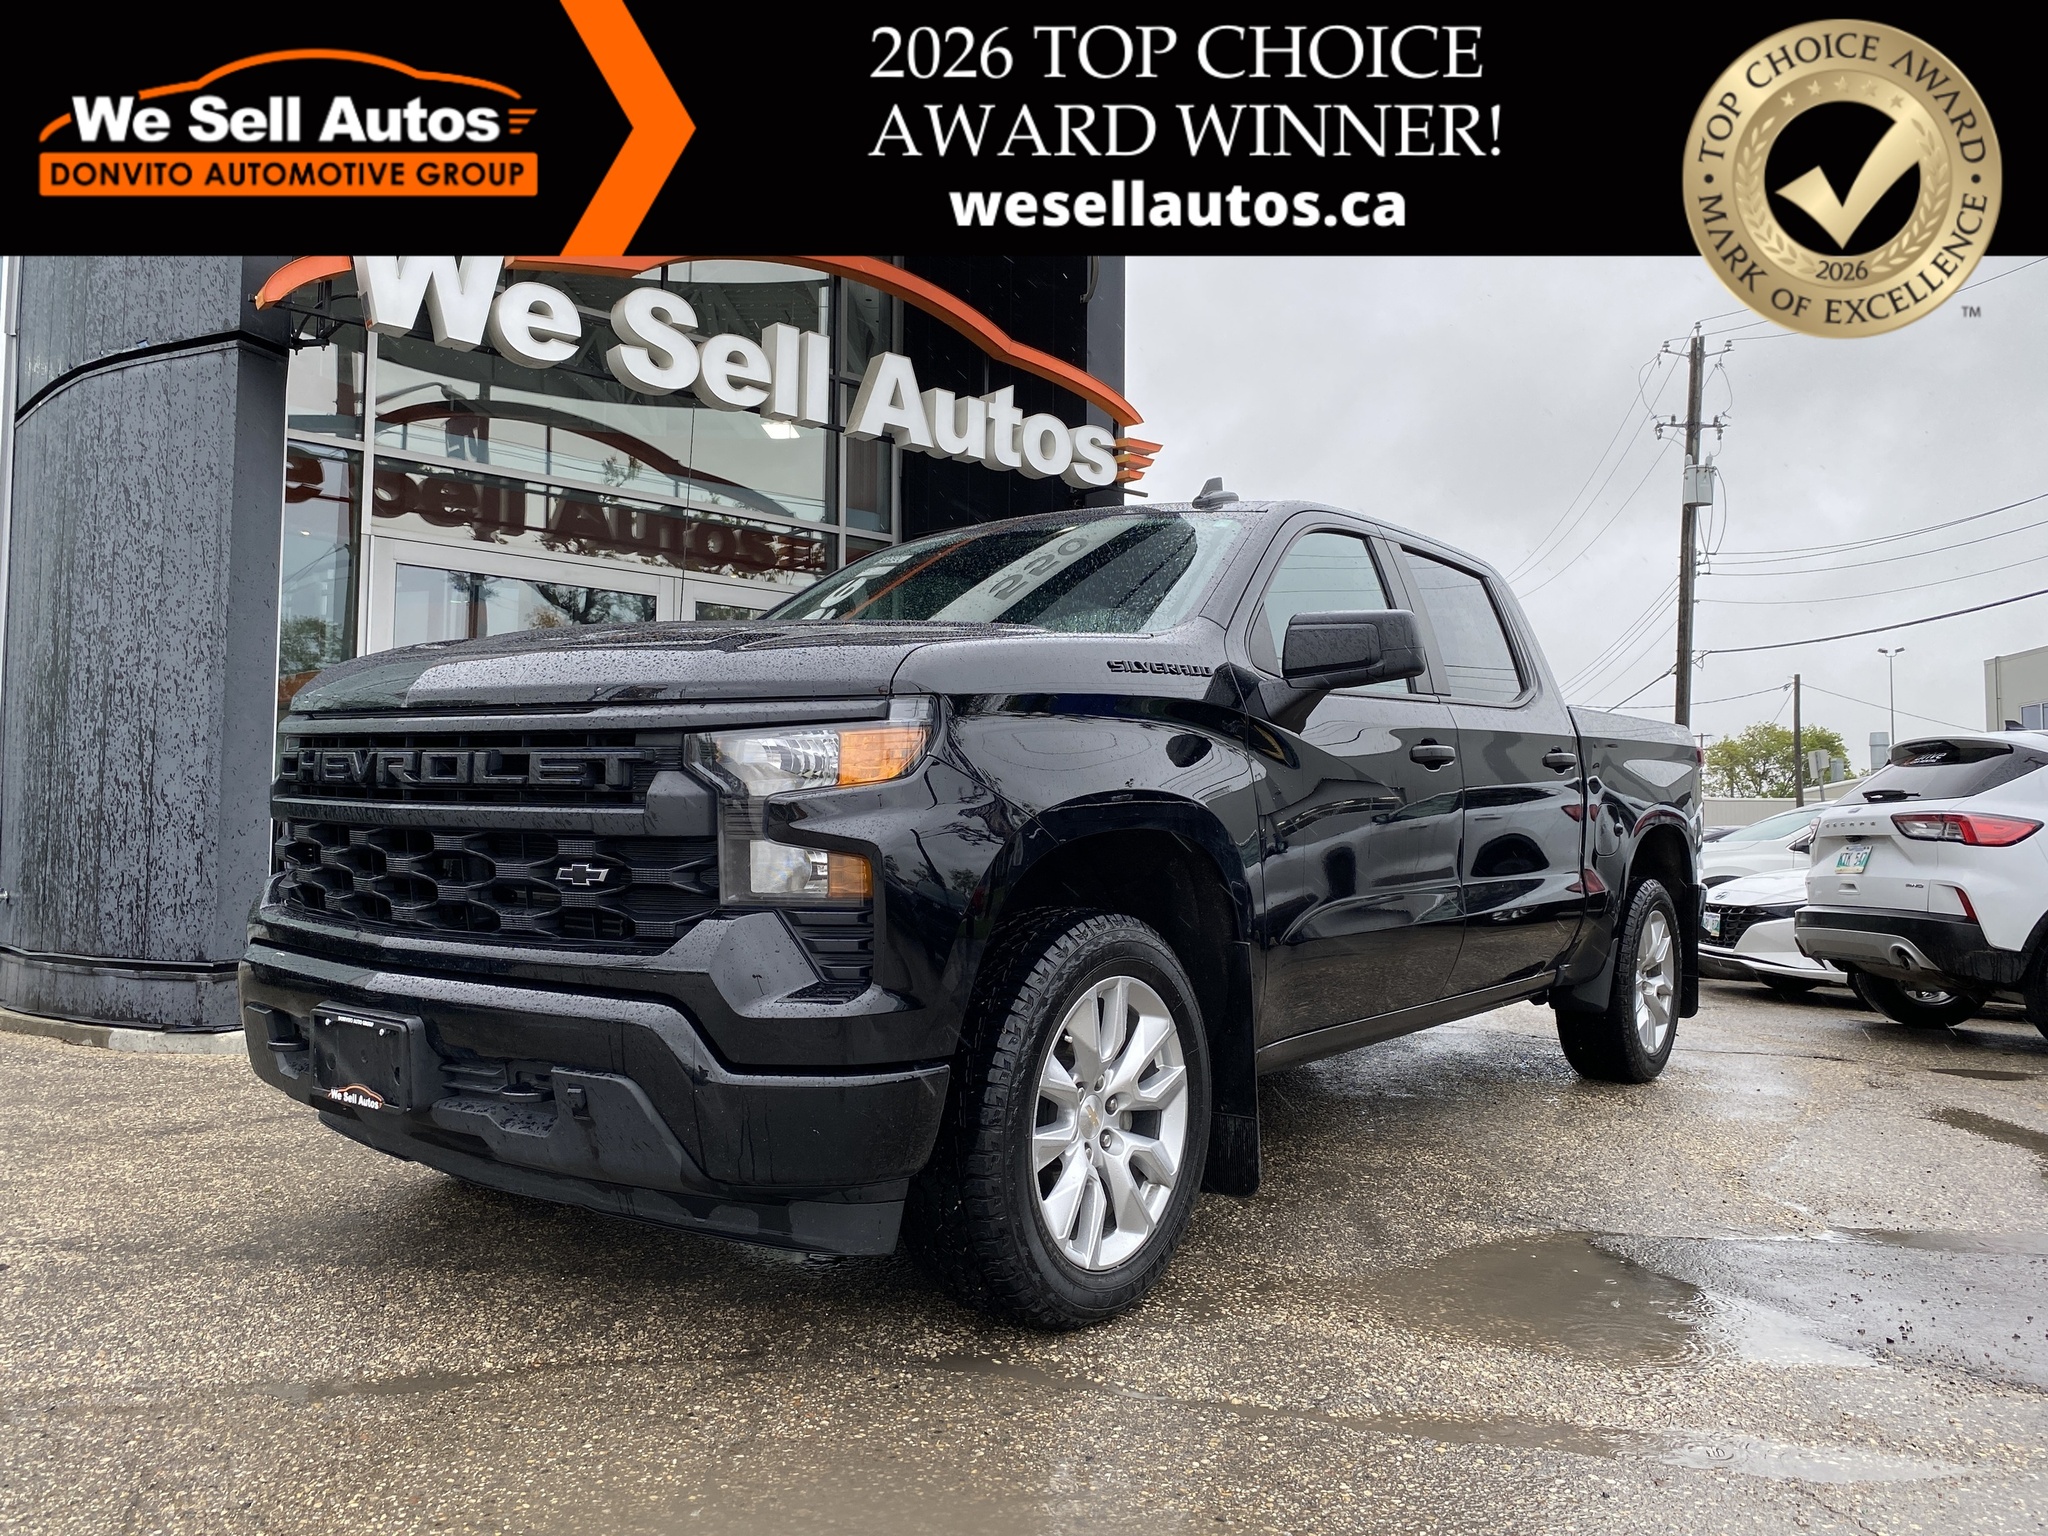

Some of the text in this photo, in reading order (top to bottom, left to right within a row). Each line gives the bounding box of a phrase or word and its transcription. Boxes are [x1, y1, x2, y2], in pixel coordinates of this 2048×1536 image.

[354, 255, 1119, 489] We Sell Autos
[1106, 659, 1214, 678] SILVERADO
[279, 746, 658, 792] CHEVROLET
[331, 1089, 379, 1109] We Sell Autos
